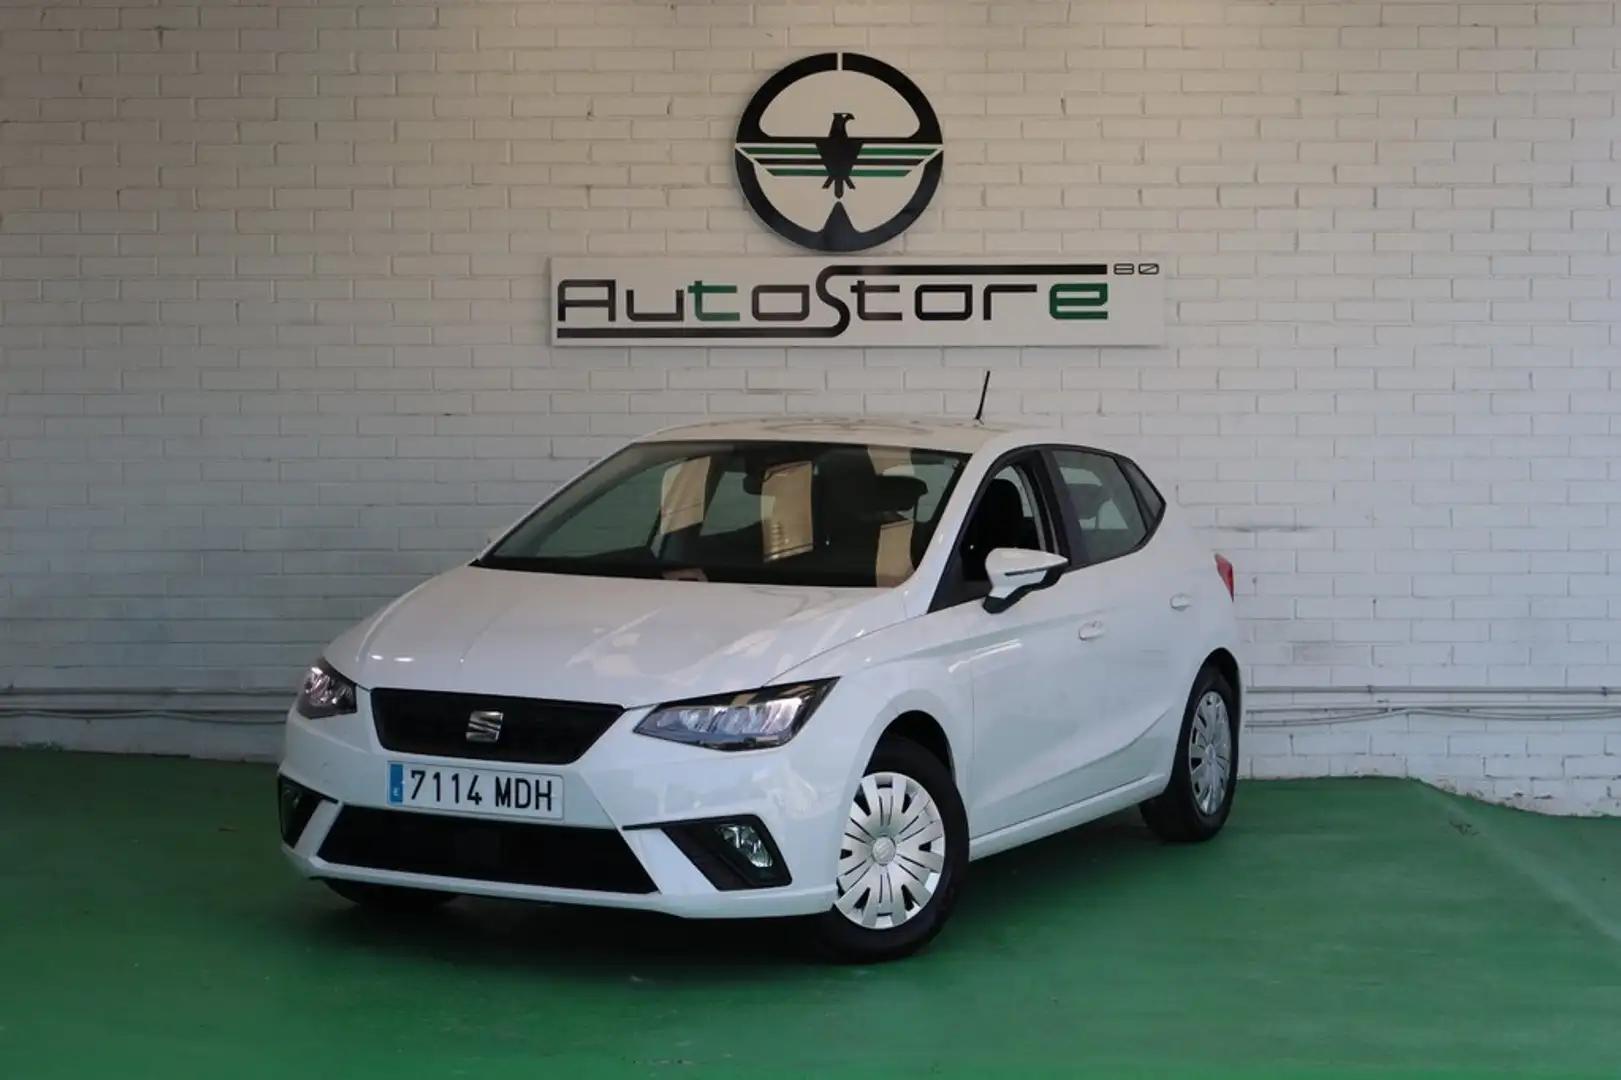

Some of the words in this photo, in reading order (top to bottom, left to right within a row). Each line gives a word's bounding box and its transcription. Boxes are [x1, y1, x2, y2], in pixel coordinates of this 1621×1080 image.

[557, 264, 1108, 338] AutoStore
[1113, 263, 1160, 275] 80
[411, 770, 482, 805] 7114
[495, 775, 552, 811] MDH
